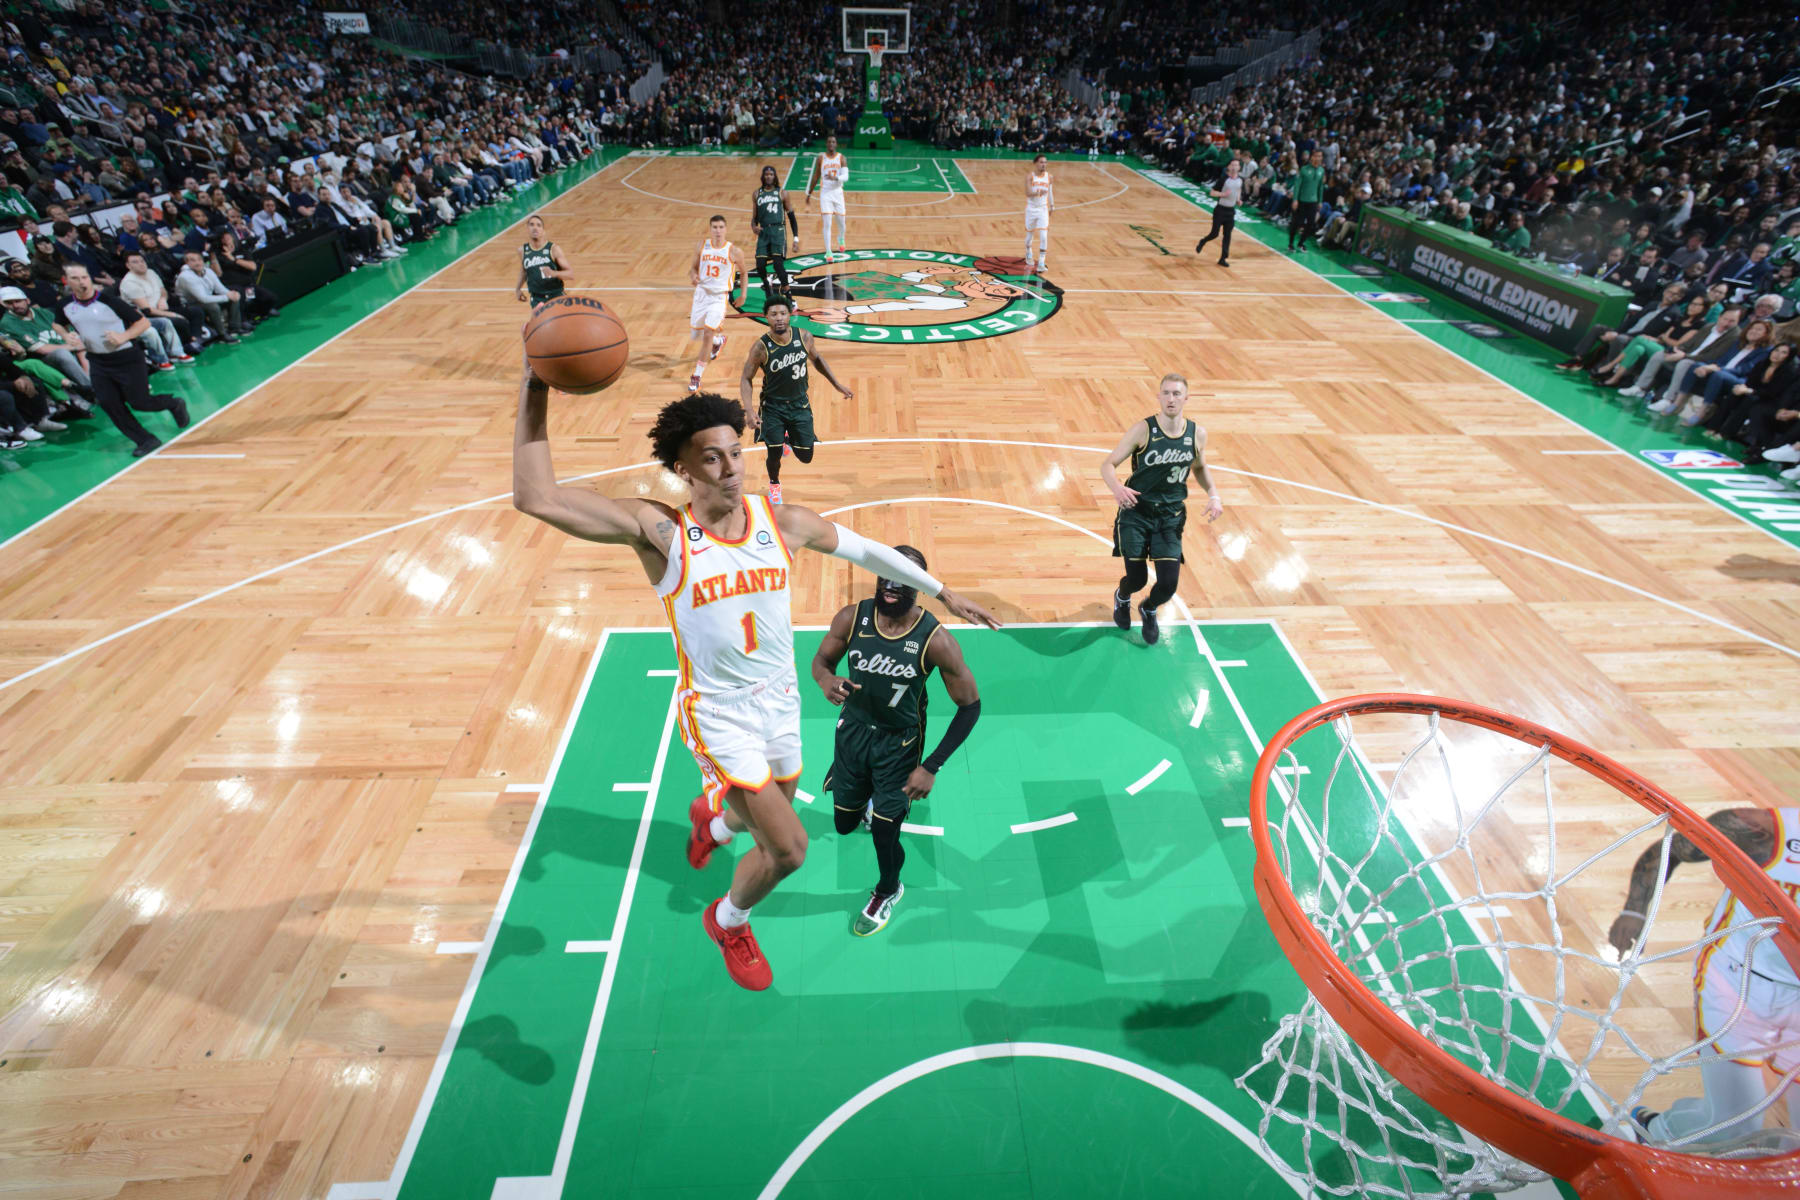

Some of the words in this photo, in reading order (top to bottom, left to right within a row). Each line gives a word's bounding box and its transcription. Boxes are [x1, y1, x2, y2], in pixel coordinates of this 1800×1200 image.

[767, 202, 778, 213] 44
[702, 254, 728, 265] ATLANTA
[798, 250, 969, 267] BOSTON
[706, 264, 720, 278] 13
[1415, 245, 1463, 278] CELTICS
[1464, 267, 1501, 294] CITY
[1501, 282, 1578, 329] EDITION
[1455, 281, 1483, 302] EDITION
[1483, 295, 1527, 323] COLLECTION
[824, 311, 1037, 341] CELTICS
[770, 350, 807, 372] Celtics
[792, 363, 806, 380] 36
[1144, 448, 1194, 467] Celtics
[1167, 465, 1189, 484] 30
[692, 567, 786, 609] ATLANTA
[861, 616, 869, 626] 6
[740, 611, 760, 655] 1
[849, 650, 918, 679] Celtics
[888, 682, 910, 708] 7
